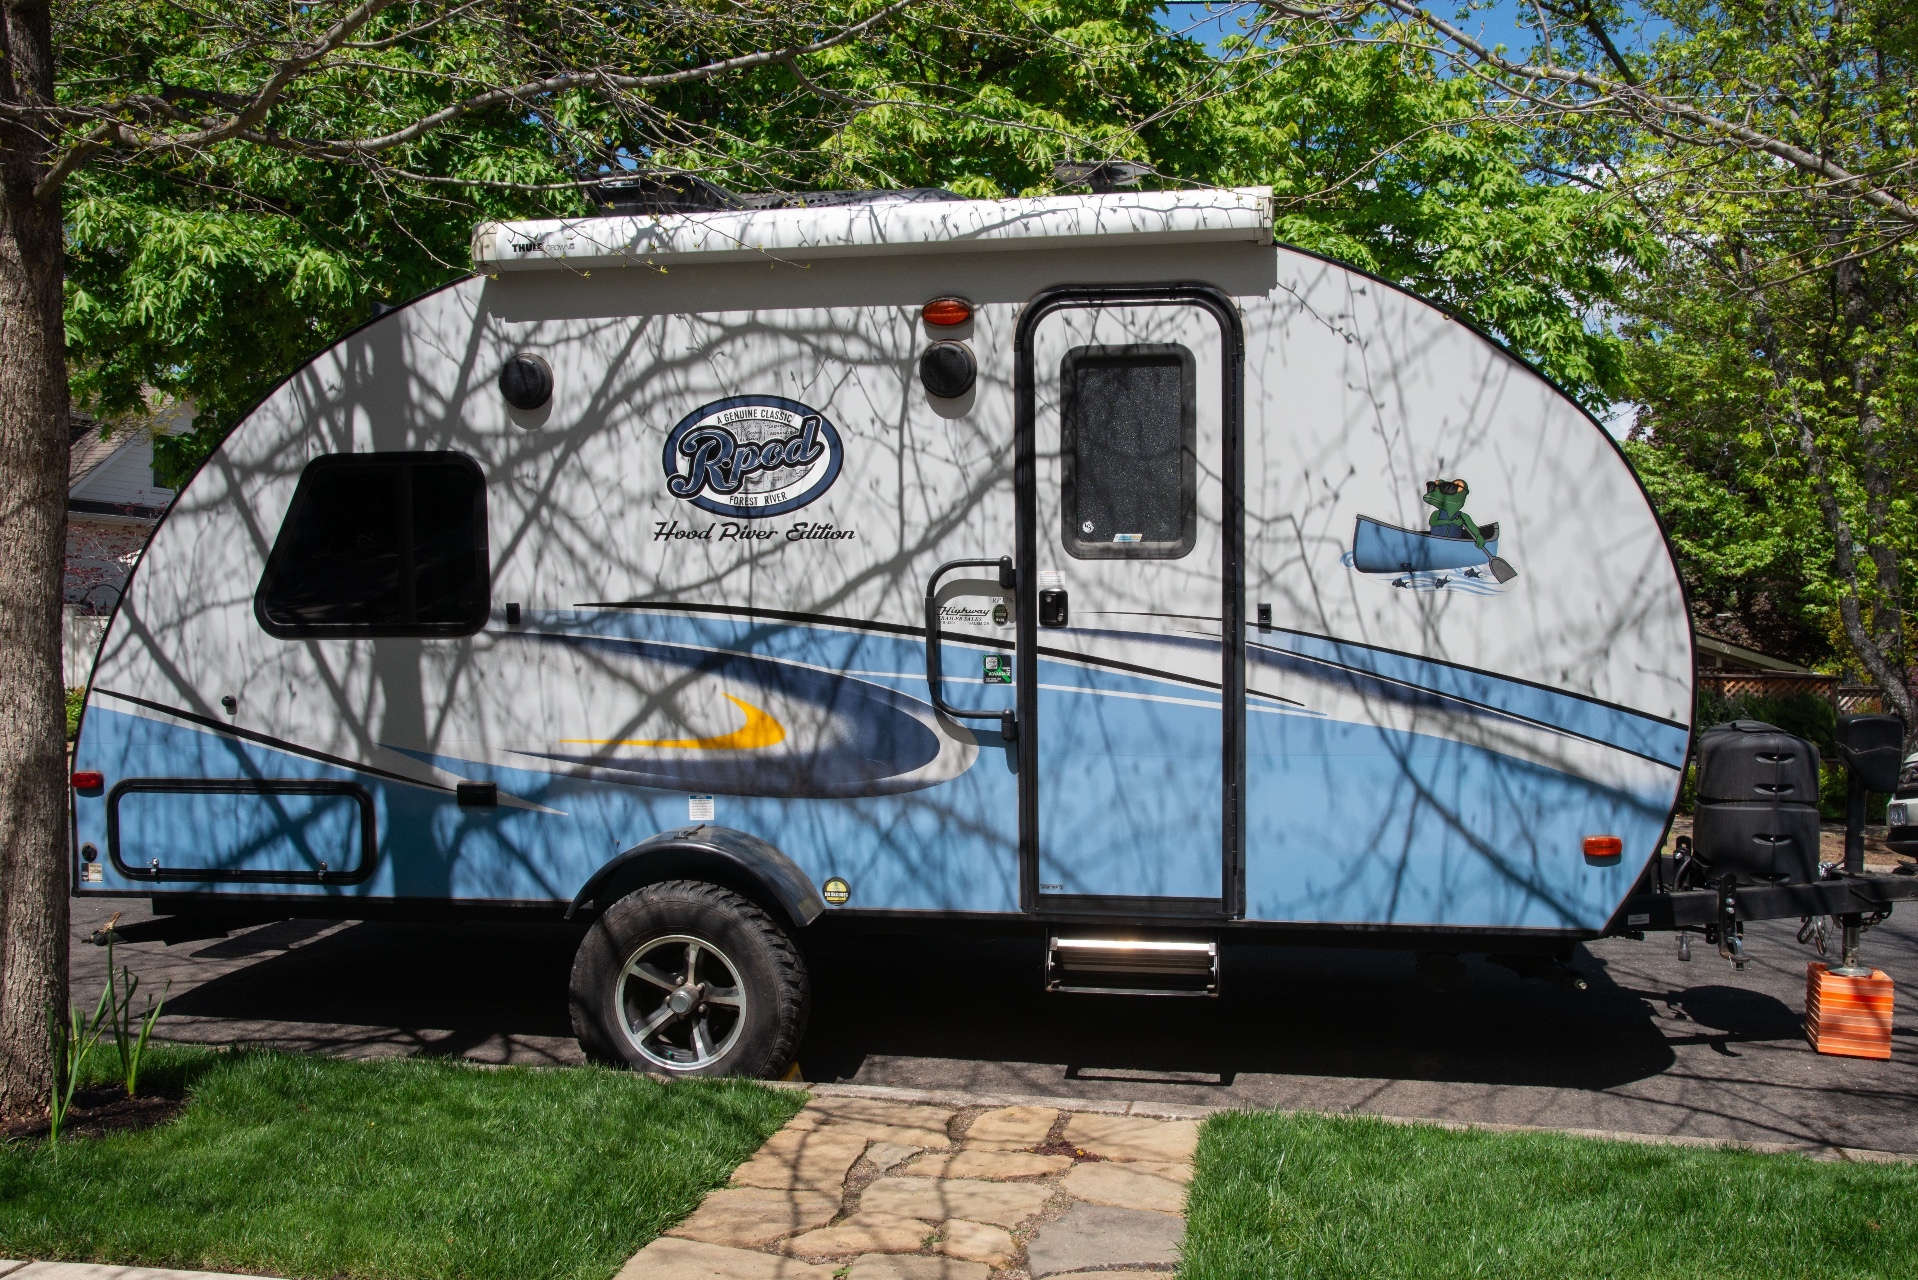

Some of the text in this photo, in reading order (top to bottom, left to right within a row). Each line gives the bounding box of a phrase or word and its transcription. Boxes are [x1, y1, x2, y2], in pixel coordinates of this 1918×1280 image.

[512, 243, 543, 252] THULE
[717, 409, 793, 425] A GENUINE CLASSIC
[729, 492, 787, 506] FOREST RIVER
[653, 521, 856, 542] Hood River Edition
[936, 606, 990, 617] Highway
